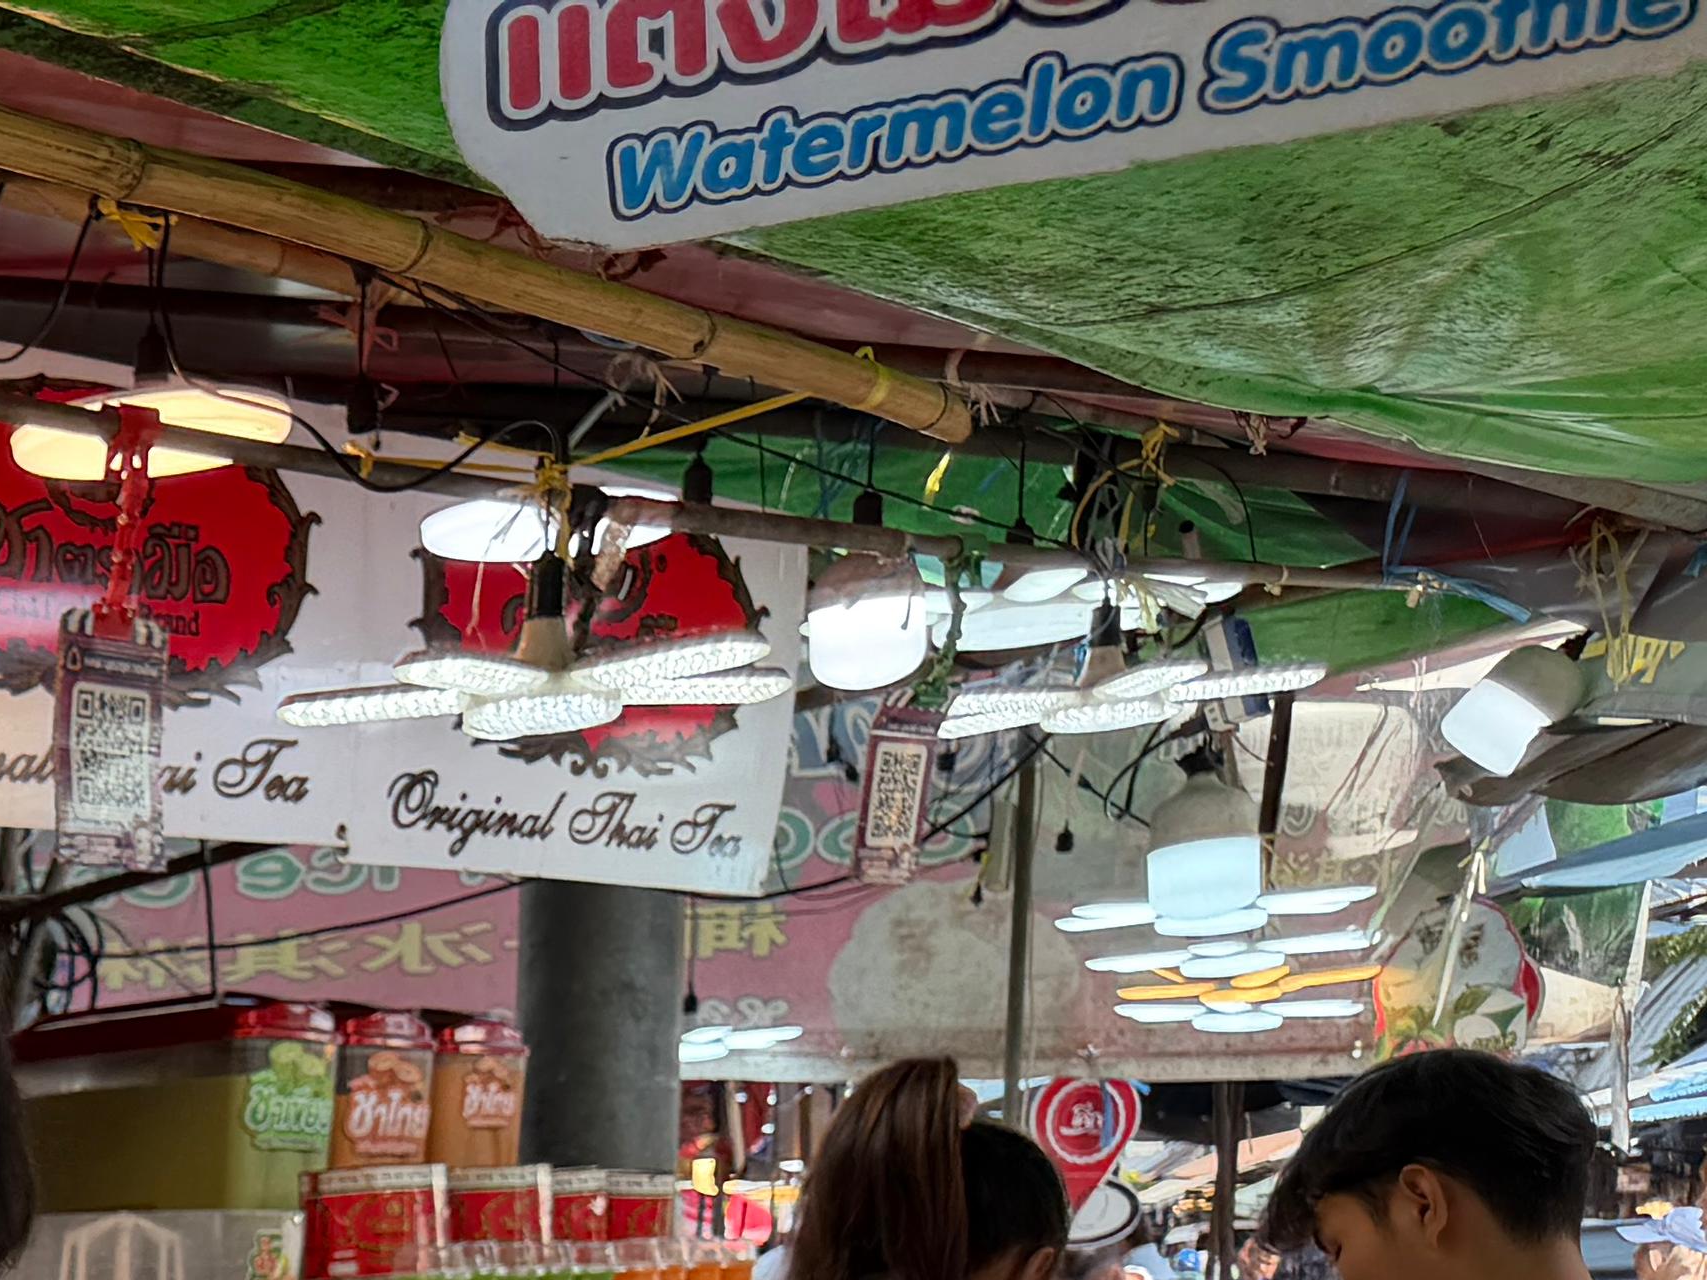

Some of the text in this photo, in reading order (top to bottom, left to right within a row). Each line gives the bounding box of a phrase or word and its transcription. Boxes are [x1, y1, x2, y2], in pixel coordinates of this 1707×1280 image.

[618, 62, 1171, 211] Watermelon
[211, 738, 311, 803] Tea
[386, 769, 566, 857] Original
[568, 790, 662, 850] Thai
[670, 802, 742, 858] Tea
